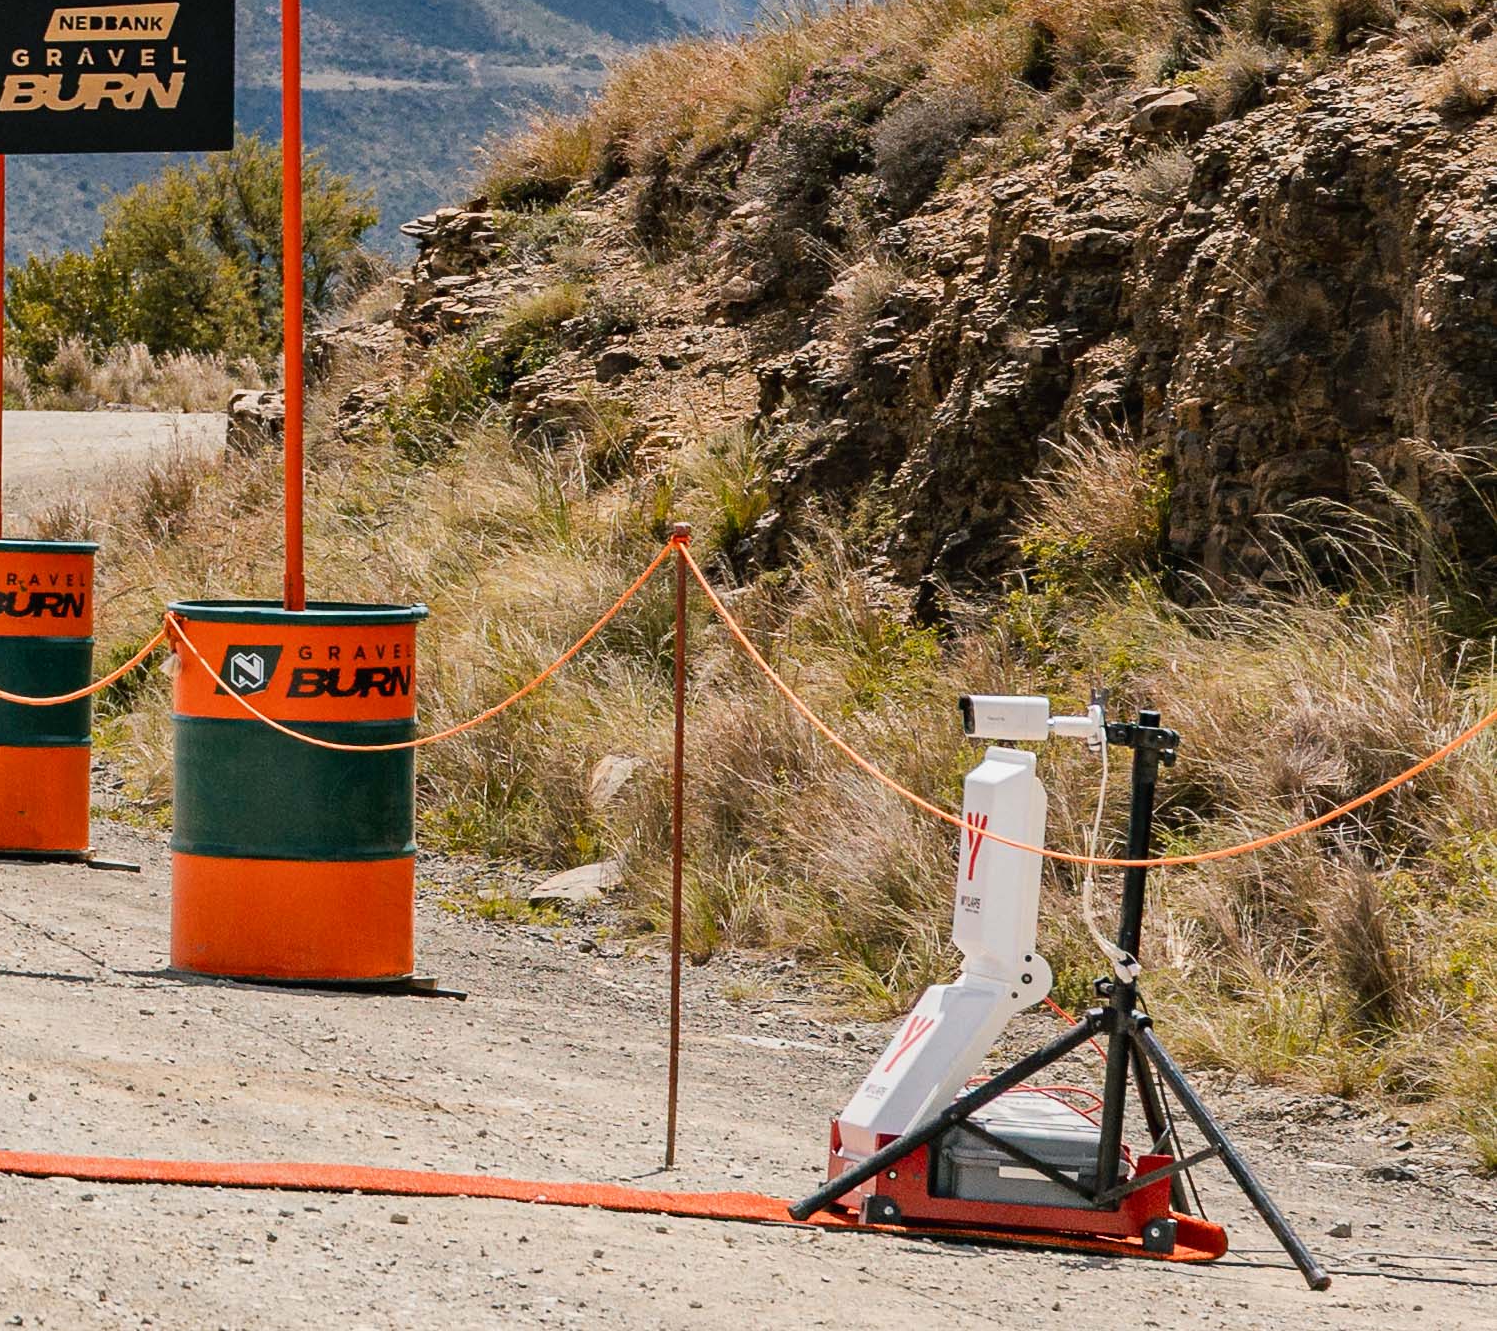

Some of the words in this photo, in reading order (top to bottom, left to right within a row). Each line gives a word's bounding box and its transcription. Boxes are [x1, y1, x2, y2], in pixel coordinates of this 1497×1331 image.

[59, 16, 162, 31] NEDBANK
[12, 46, 187, 66] GRAVEL
[286, 665, 411, 698] BURN
